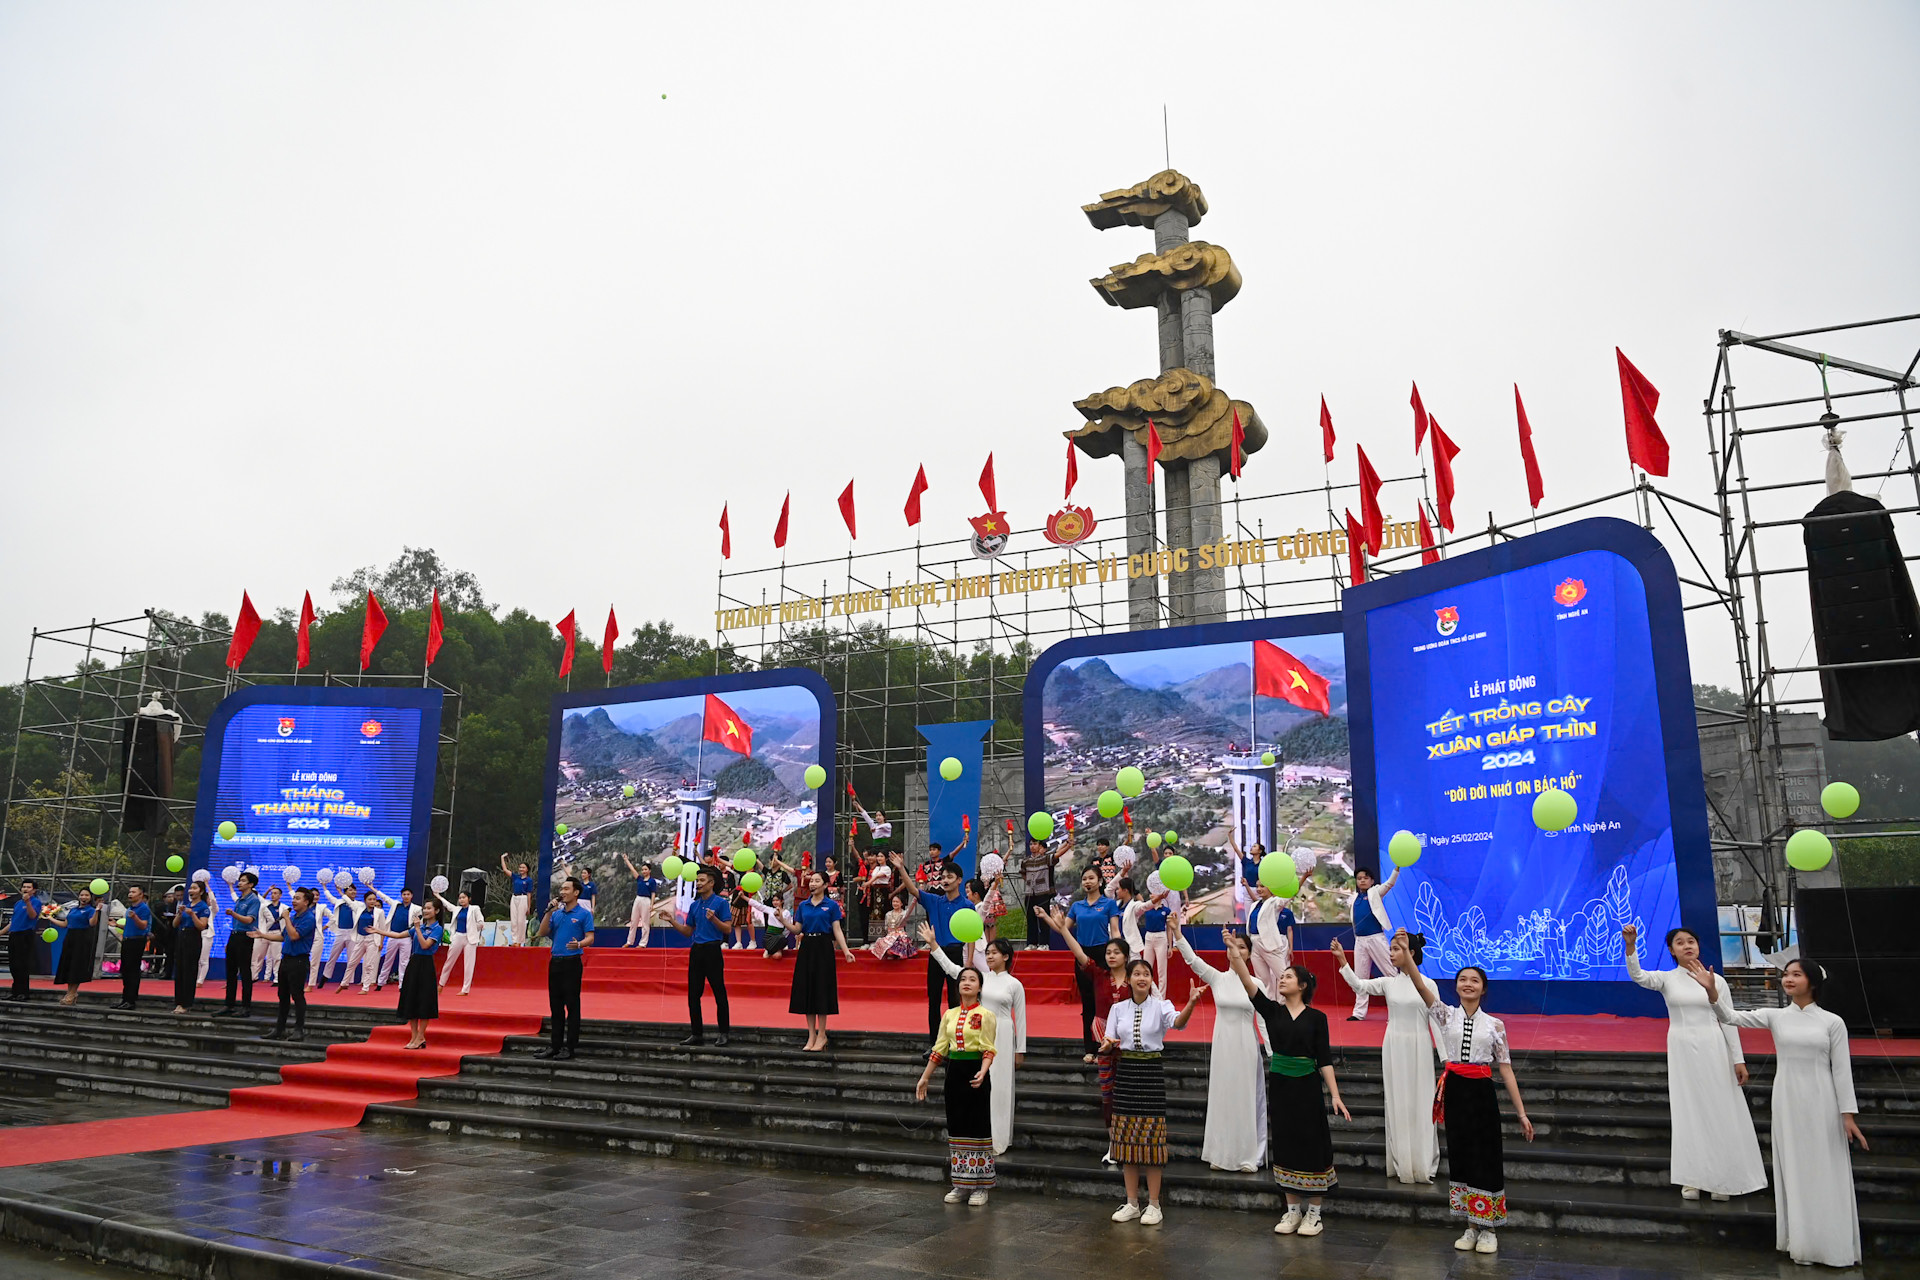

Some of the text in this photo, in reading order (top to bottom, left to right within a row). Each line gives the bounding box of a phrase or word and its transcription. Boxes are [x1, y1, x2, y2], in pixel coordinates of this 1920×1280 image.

[715, 604, 772, 631] THANH
[779, 595, 822, 623] NIÊN
[830, 589, 882, 616] XUNG
[890, 580, 941, 608] KÍCH,
[944, 573, 990, 600] TÌNH
[1000, 559, 1087, 593] NGUYỆN
[1096, 552, 1117, 582] VÌ
[1128, 545, 1189, 580] CUỘC
[1198, 534, 1265, 569] SỐNG
[1277, 528, 1347, 564] CỘNG
[1469, 675, 1536, 698] LỄ PHÁT ĐỘNG
[1426, 694, 1592, 735] TẾT TRỒNG CÂY
[1426, 717, 1597, 760] XUÂN GIÁP THÌN
[1481, 750, 1536, 771] 2024
[281, 783, 345, 801] THÁNG
[1470, 783, 1487, 800] ĐỜI
[1490, 780, 1511, 798] NHỚ
[1516, 780, 1531, 795] ƠN
[1534, 774, 1557, 793] BÁC
[251, 800, 372, 818] THANH NIÊN
[287, 818, 331, 829] 2024
[1583, 821, 1607, 834] Nghệ
[1608, 820, 1621, 830] An
[1430, 831, 1493, 846] Ngày 25/02/2024
